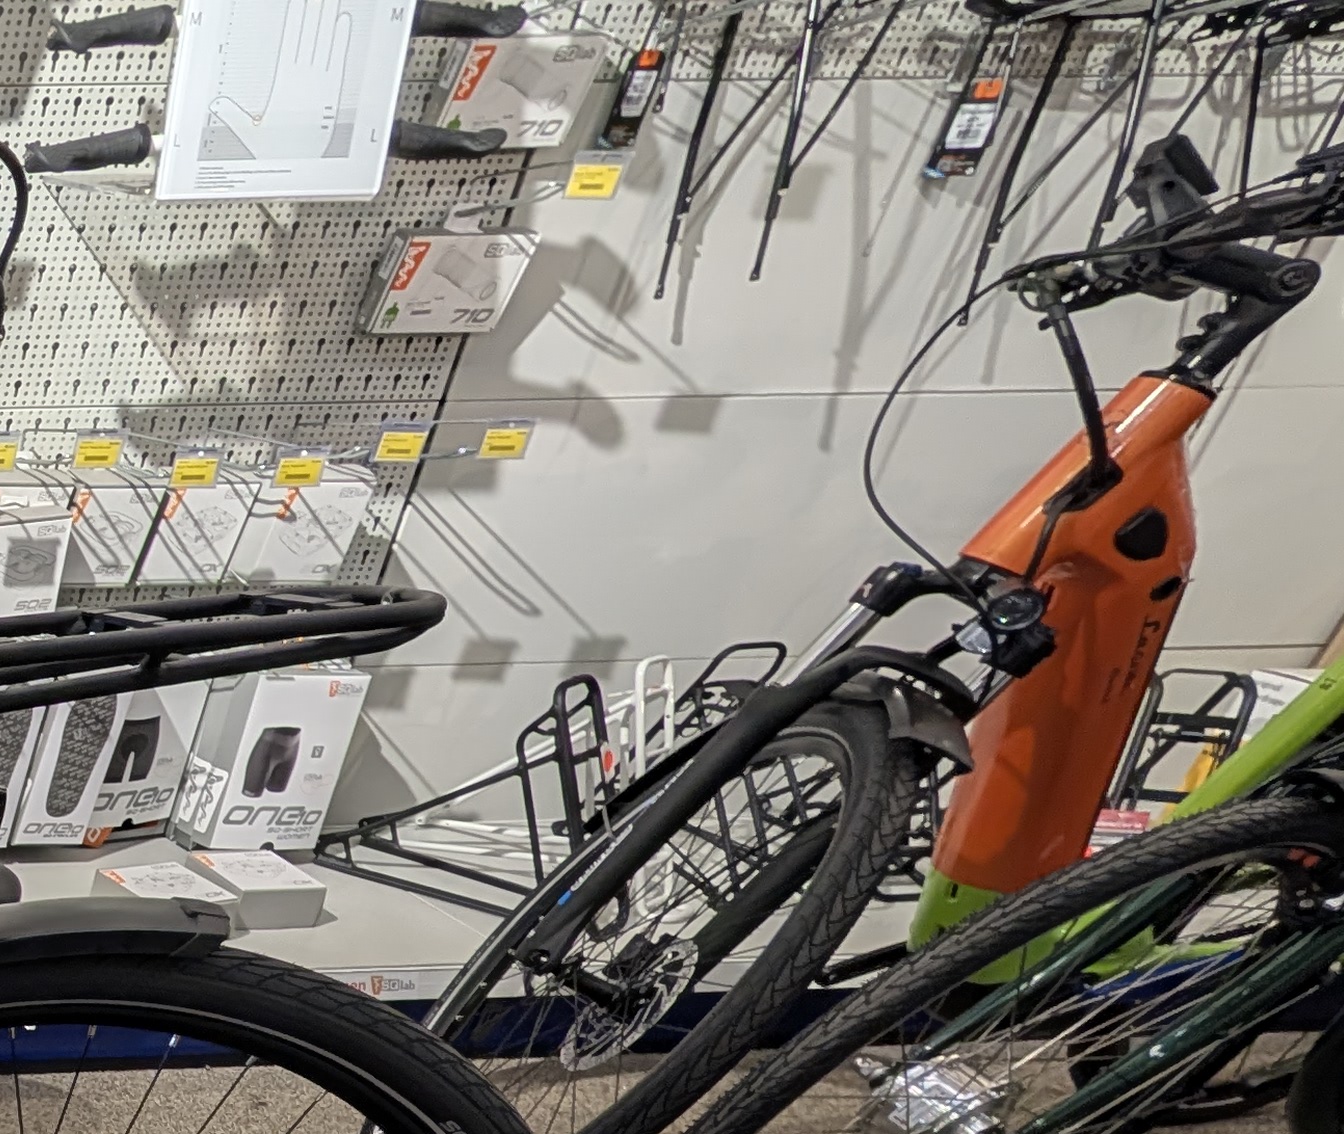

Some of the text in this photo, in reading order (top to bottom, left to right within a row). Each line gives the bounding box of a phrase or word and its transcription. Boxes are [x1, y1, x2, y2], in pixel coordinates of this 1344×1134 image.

[190, 12, 203, 26] M
[520, 120, 564, 136] 710
[451, 308, 495, 324] 710
[383, 978, 416, 991] SQlab
